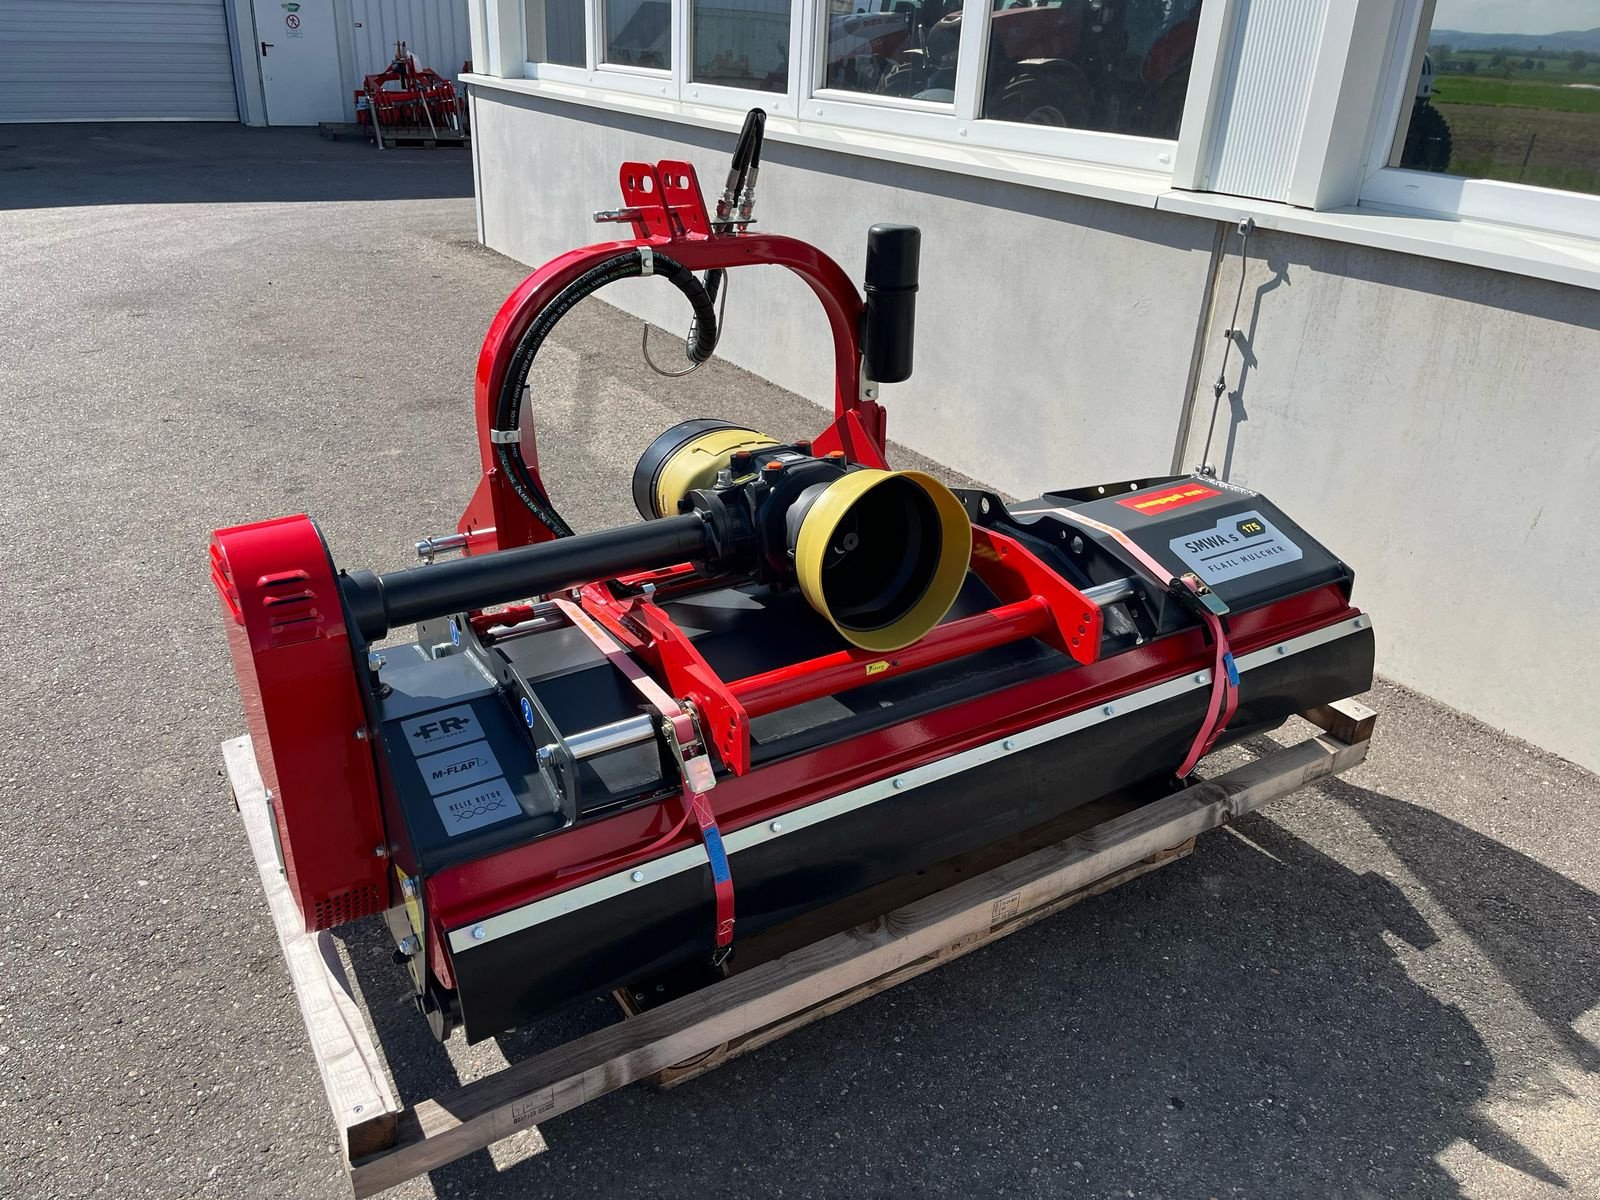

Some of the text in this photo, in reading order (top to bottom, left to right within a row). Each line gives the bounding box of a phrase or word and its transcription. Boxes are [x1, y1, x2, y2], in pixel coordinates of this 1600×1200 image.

[521, 359, 530, 370] 400
[526, 348, 534, 359] WP
[1185, 522, 1261, 553] SMWA s 175
[1207, 546, 1285, 572] FLAIL MULCHER
[419, 716, 462, 740] FR
[432, 762, 476, 780] M-FLAP
[449, 790, 502, 812] HELIX ROTOR
